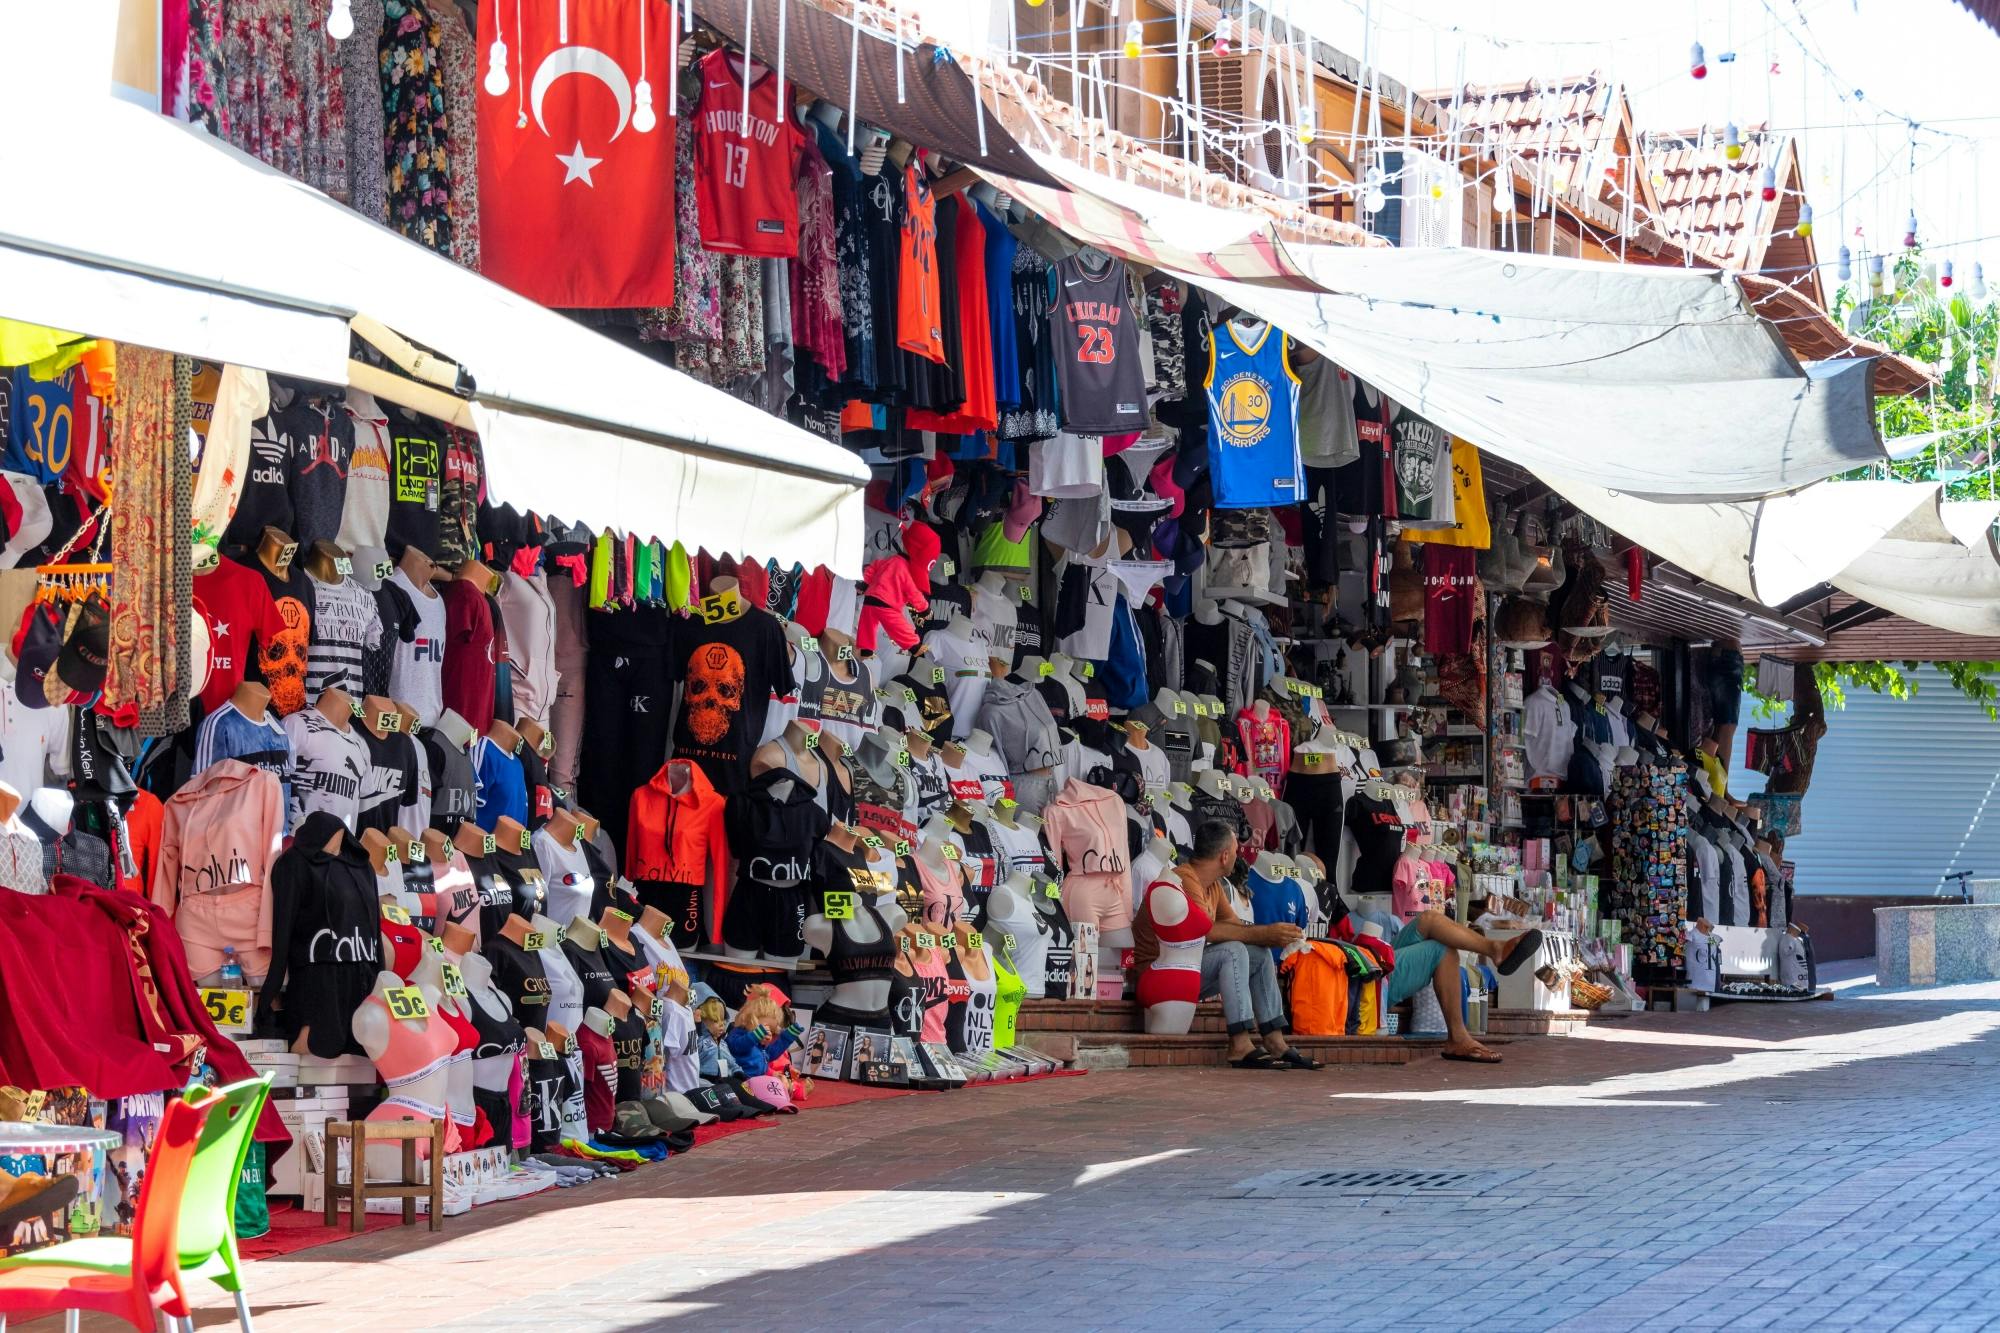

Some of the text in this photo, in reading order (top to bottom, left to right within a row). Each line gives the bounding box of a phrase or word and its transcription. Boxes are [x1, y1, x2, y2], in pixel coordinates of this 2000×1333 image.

[705, 109, 780, 147] HOUSTON
[724, 141, 749, 189] 13
[1077, 324, 1116, 365] 23
[1220, 370, 1273, 393] GOLDEN STATE
[1247, 394, 1263, 408] 30
[25, 394, 73, 475] 30
[1220, 425, 1272, 448] WARRIORS
[337, 558, 353, 574] 5€
[375, 562, 393, 579] 5€
[704, 597, 740, 621] 5€
[801, 637, 818, 650] 5€
[839, 646, 852, 659] 5€
[934, 668, 944, 681] 5€
[822, 686, 864, 715] EA7
[380, 713, 398, 730] 5€
[806, 735, 818, 748] 5€
[80, 749, 94, 780] Klein
[313, 771, 358, 801] PUMA
[484, 836, 497, 850] 5€
[865, 837, 883, 847] 5€
[896, 843, 910, 856] 5€
[387, 847, 398, 861] 5€
[409, 843, 423, 859] 5€
[1274, 865, 1285, 876] 5€
[453, 887, 474, 910] NIKE
[826, 893, 852, 916] 5€
[527, 933, 545, 947] 5€
[918, 934, 933, 947] 5€
[941, 935, 957, 948] 5€
[969, 934, 983, 946] 5€
[442, 964, 466, 995] 5€
[205, 992, 244, 1024] 5€
[385, 988, 427, 1018] 5€
[651, 1000, 664, 1016] 5€
[541, 1042, 558, 1058] 5€
[26, 1095, 43, 1117] 5€
